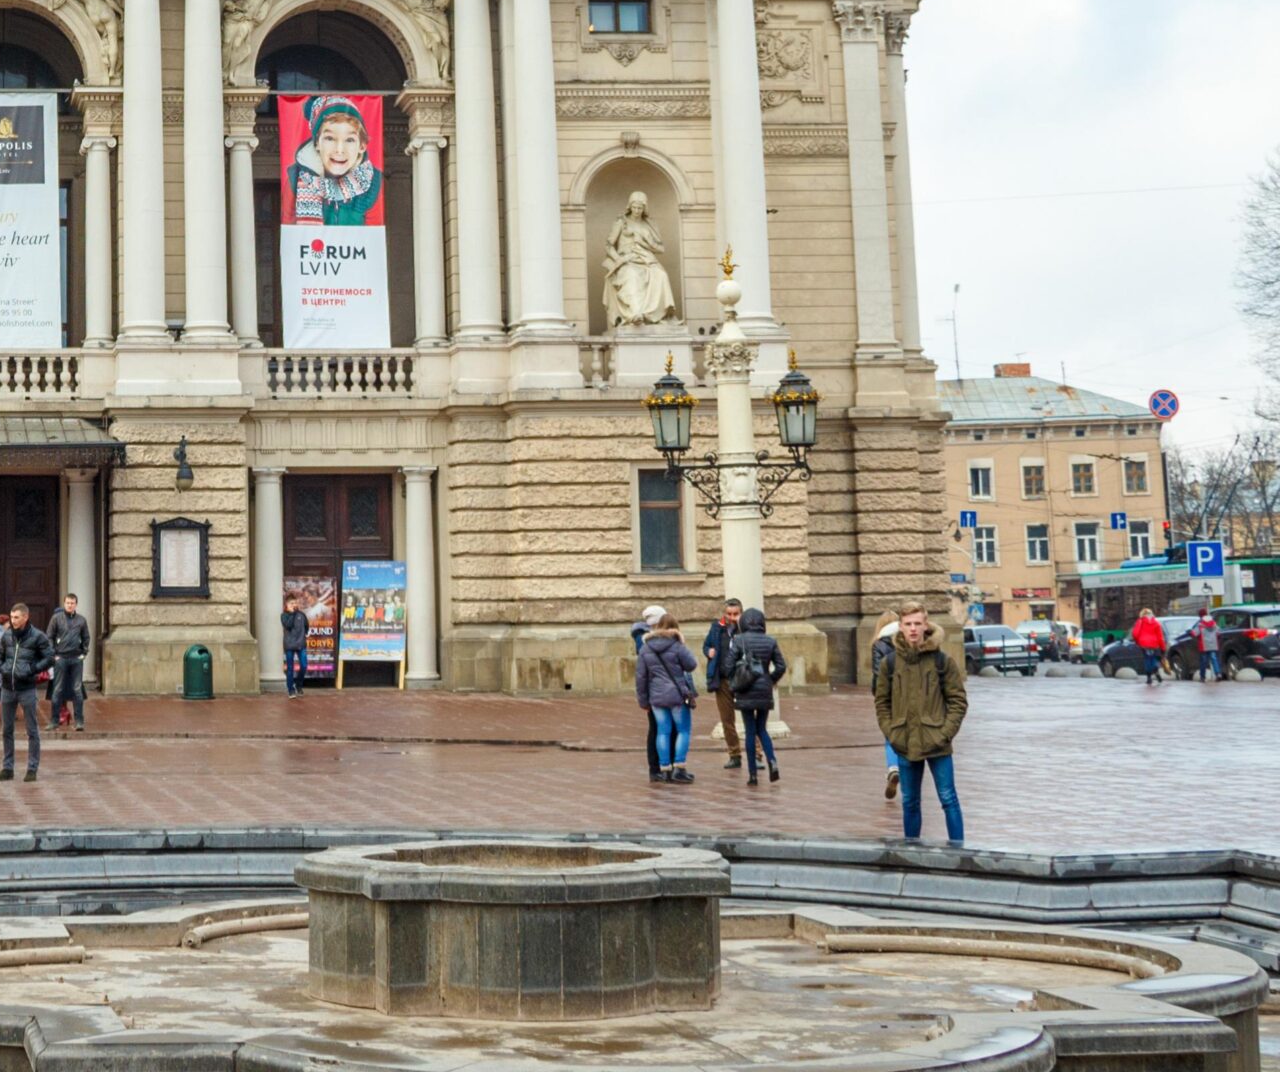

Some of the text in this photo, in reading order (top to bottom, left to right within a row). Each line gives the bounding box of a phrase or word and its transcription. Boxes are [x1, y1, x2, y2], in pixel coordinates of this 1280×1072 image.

[10, 230, 50, 245] heart
[300, 261, 342, 276] LVIV
[301, 288, 372, 296] ЗУСТРІНЕМОСЯ
[1196, 546, 1215, 574] P
